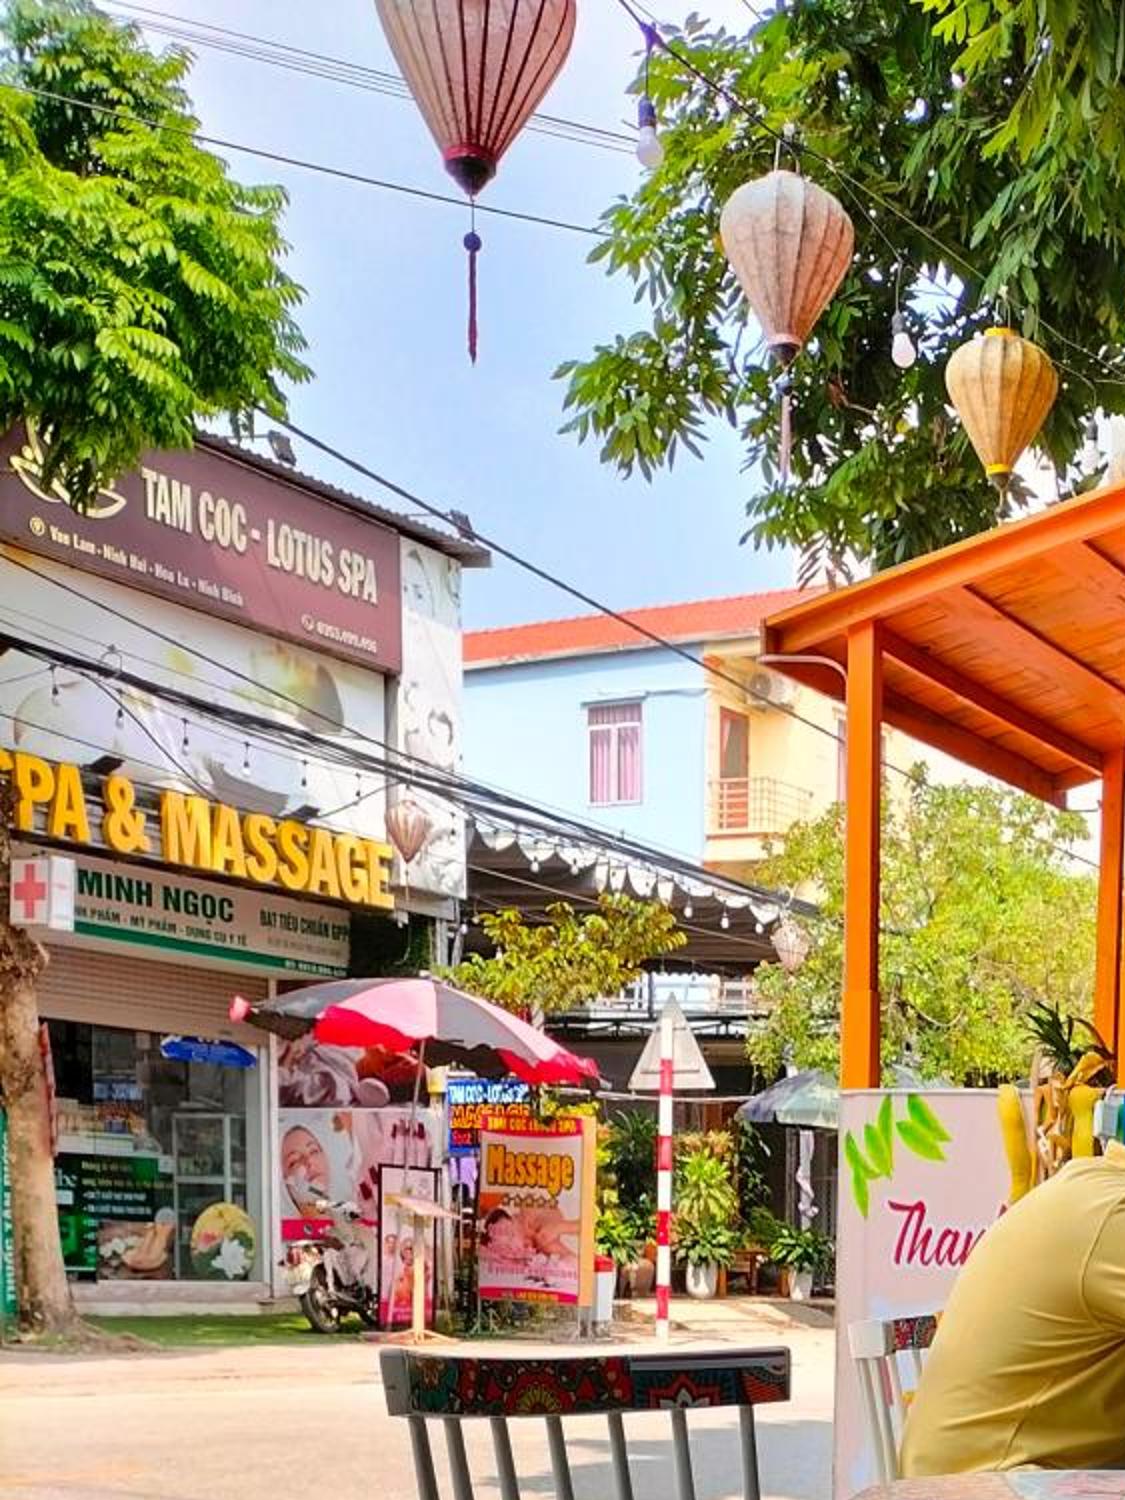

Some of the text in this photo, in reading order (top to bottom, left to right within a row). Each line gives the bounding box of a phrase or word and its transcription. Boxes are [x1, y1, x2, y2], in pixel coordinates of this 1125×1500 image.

[141, 466, 193, 534] TAM
[198, 490, 247, 553] COC
[266, 517, 335, 587] LOTUS
[337, 547, 378, 606] SPA
[103, 543, 127, 566] Ninh
[197, 579, 220, 598] Ninh
[104, 775, 151, 853] &
[160, 790, 395, 910] MASSAGE
[77, 868, 234, 925] MINH NGỌC
[487, 1144, 574, 1199] Massage
[888, 1200, 1007, 1265] Than
